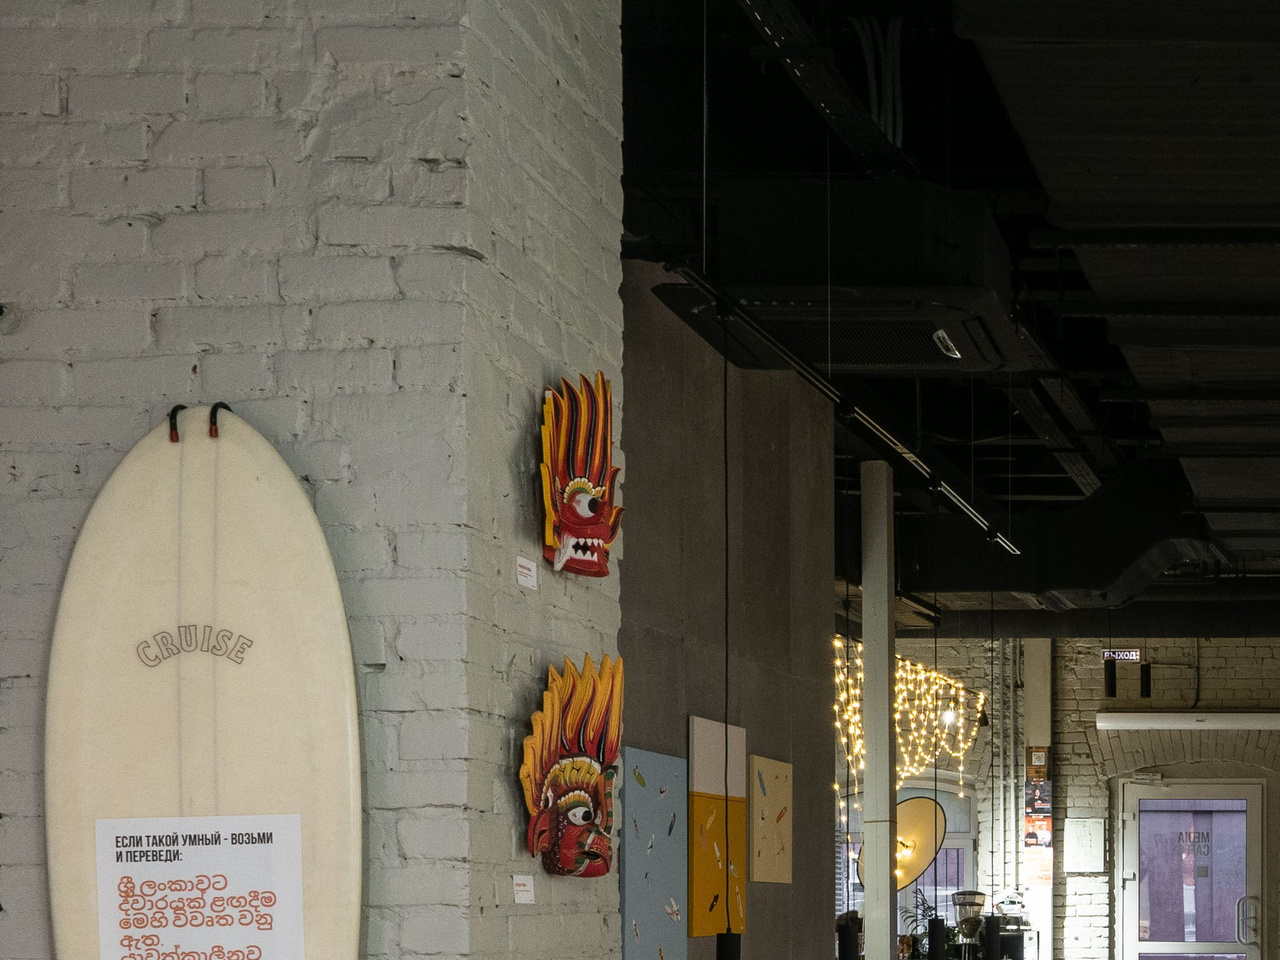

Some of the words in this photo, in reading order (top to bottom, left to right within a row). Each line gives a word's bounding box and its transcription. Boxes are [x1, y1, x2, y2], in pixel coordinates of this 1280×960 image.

[136, 624, 254, 668] CRUISE
[115, 835, 143, 848] ЕСЛИ
[145, 832, 179, 848] ТАКОЙ
[181, 831, 221, 846] УМНЫЙ
[231, 832, 273, 845] ВОЗЬМИ
[116, 850, 123, 863] И
[125, 849, 183, 863] ПЕРЕВЕДИ:
[140, 874, 228, 897] ලංකාවට
[210, 890, 277, 913] ළඟදීම
[119, 911, 168, 929] මෙහි
[172, 909, 234, 928] විවෘත
[238, 909, 273, 930] වනු
